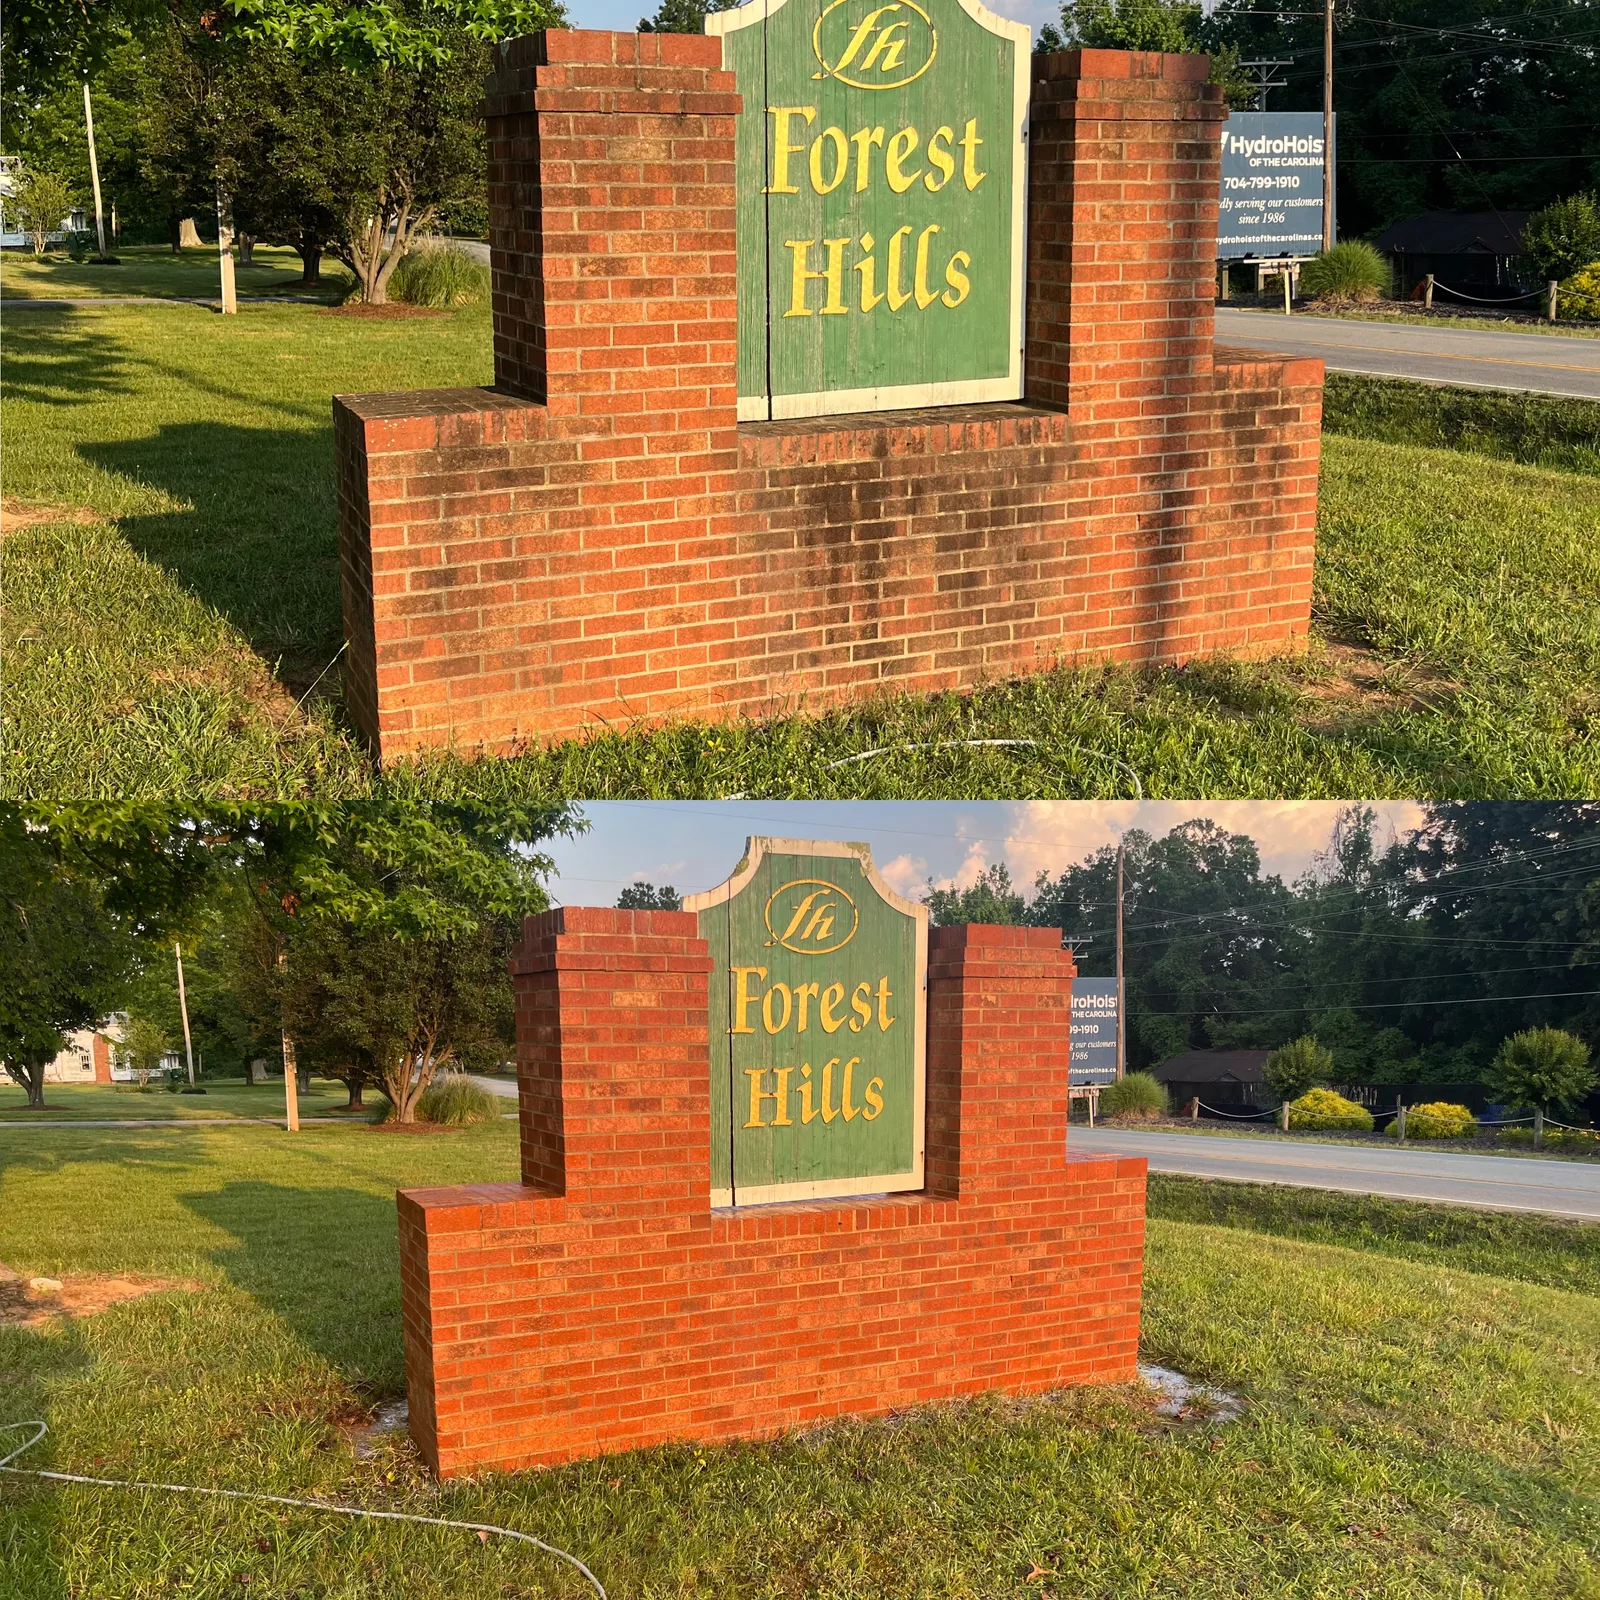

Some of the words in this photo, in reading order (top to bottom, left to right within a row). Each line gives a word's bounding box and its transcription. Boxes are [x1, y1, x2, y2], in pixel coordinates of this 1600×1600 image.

[760, 106, 987, 195] Forest
[1230, 135, 1324, 157] HydroHois
[1249, 158, 1262, 167] OF
[1262, 158, 1281, 166] THE
[1223, 176, 1300, 189] 704-799-1910
[1218, 198, 1233, 212] dly
[1234, 197, 1266, 211] serving
[1267, 199, 1282, 208] our
[1284, 198, 1324, 207] customers
[1238, 213, 1260, 224] since
[1262, 212, 1285, 224] 1986
[782, 224, 972, 318] Hills
[725, 966, 896, 1035] Forest
[1071, 1051, 1089, 1060] 1986
[743, 1056, 884, 1128] Hills
